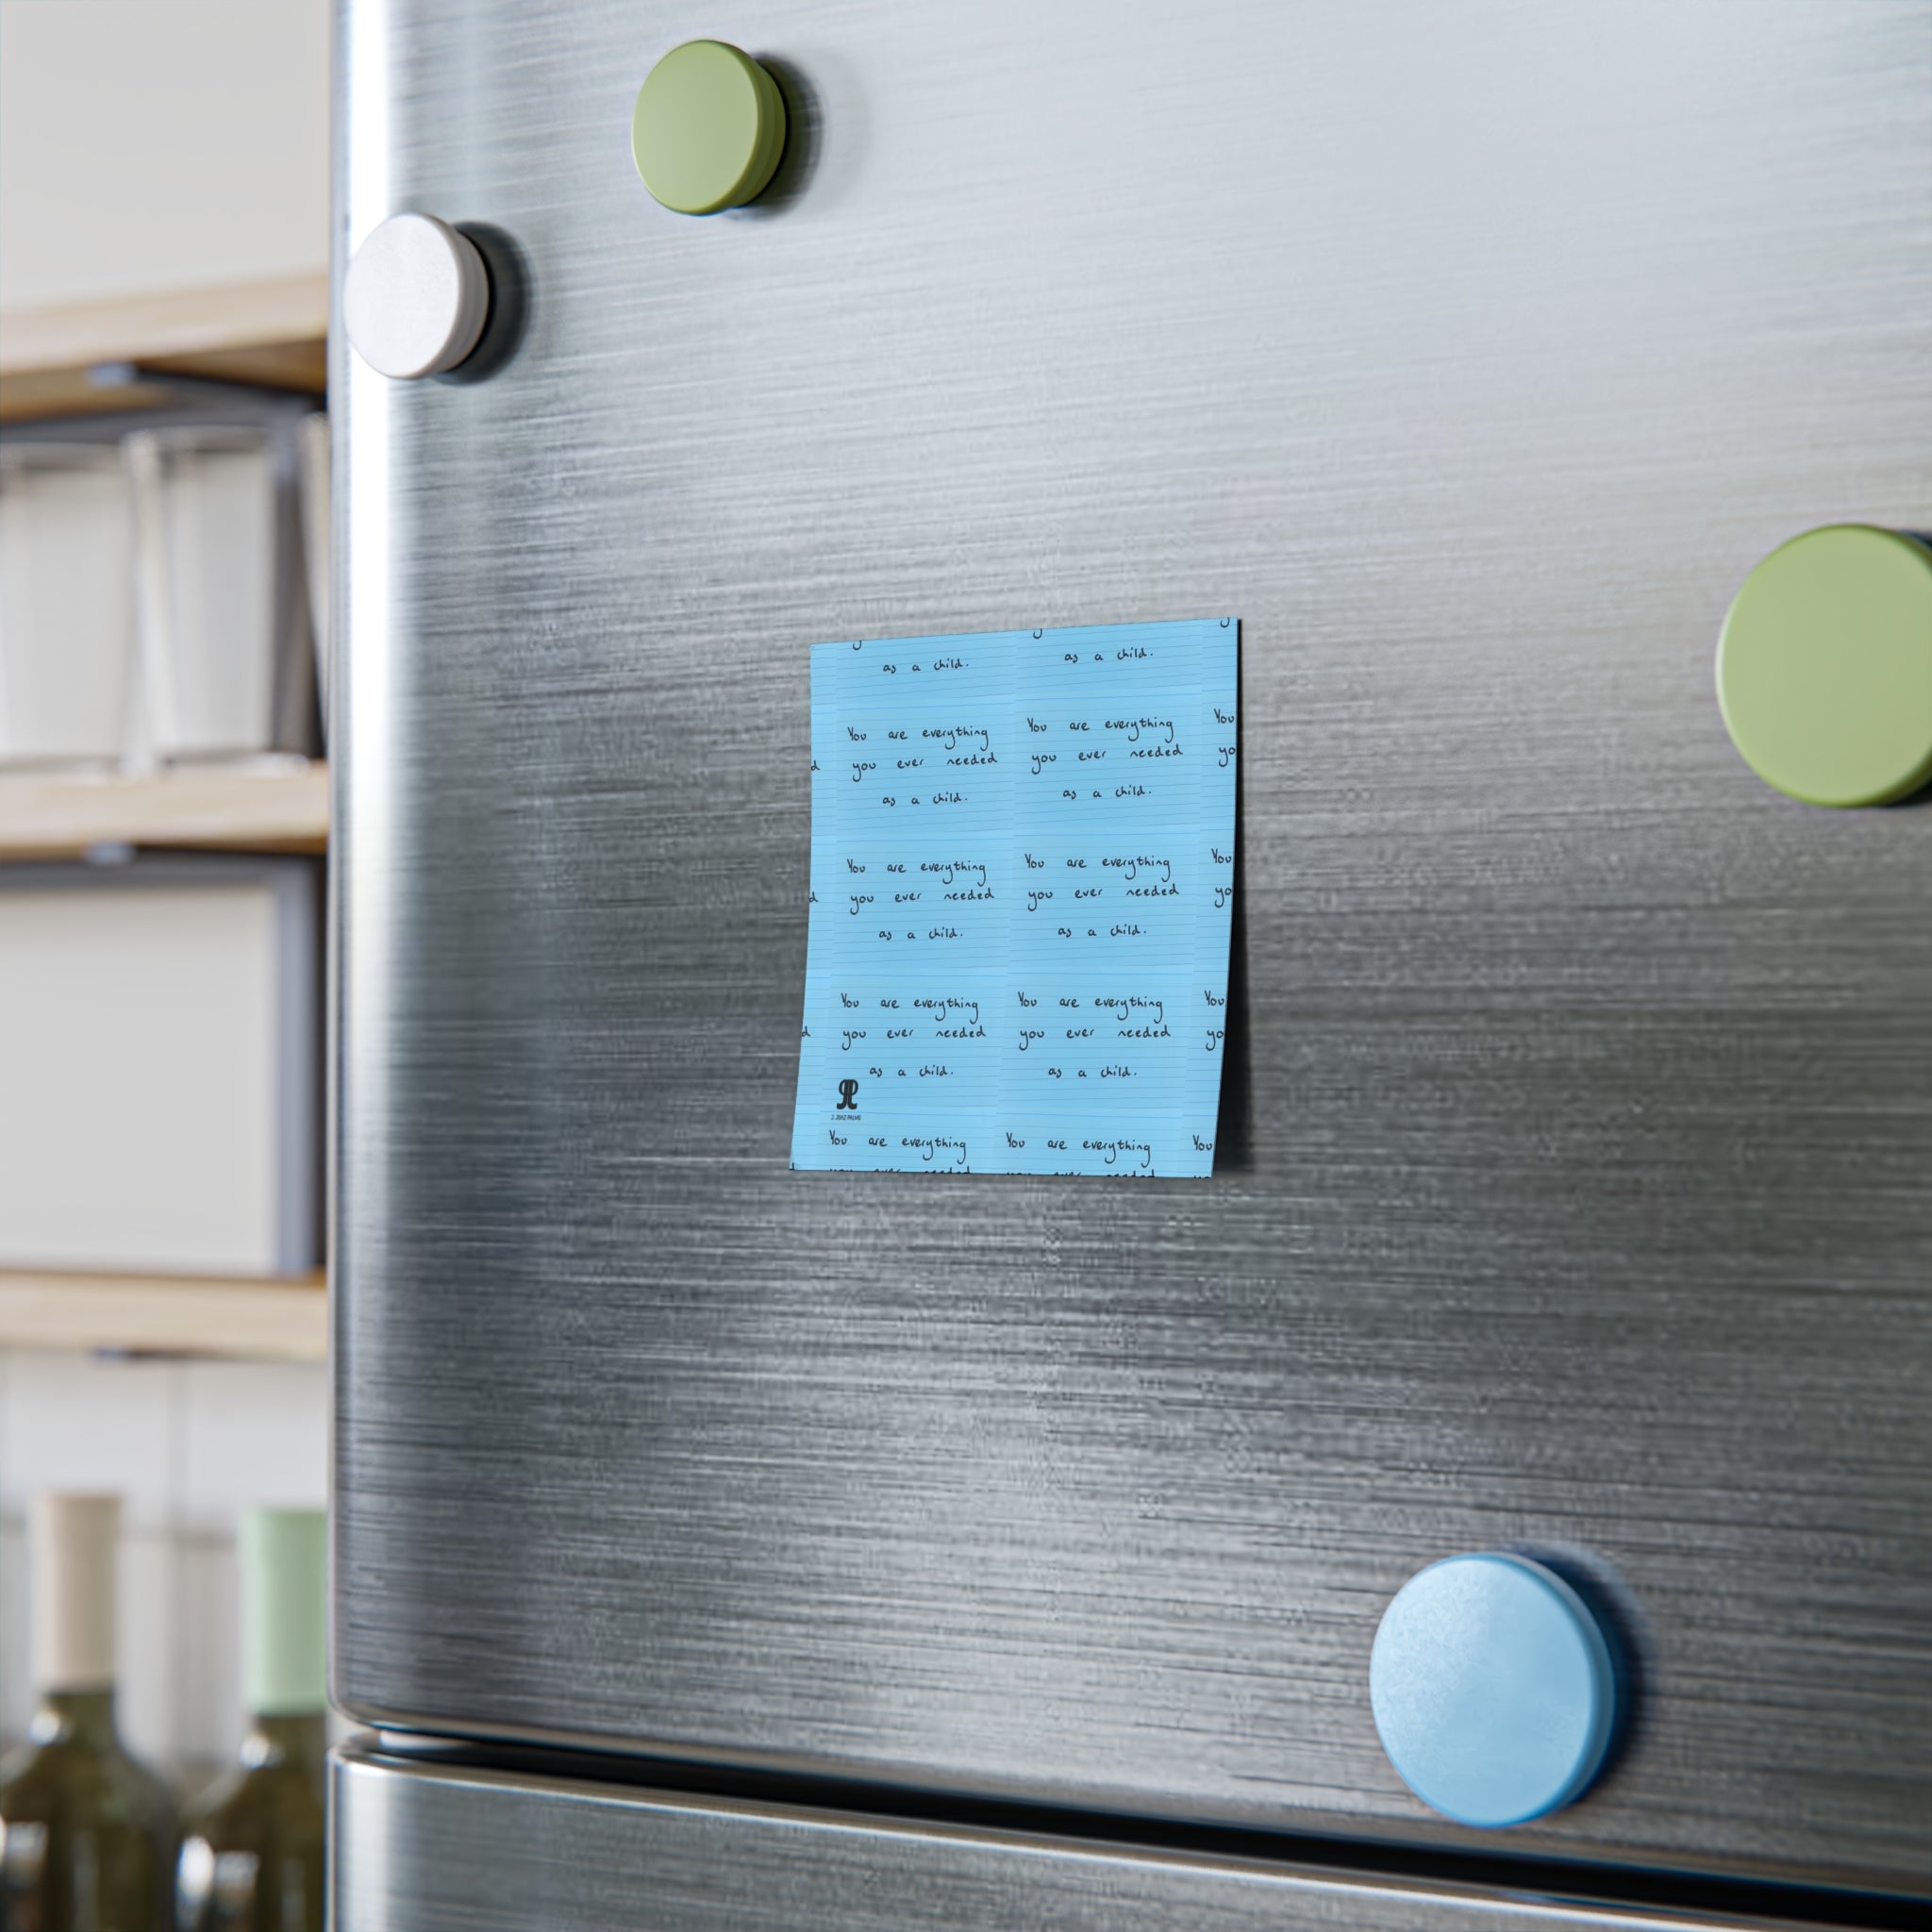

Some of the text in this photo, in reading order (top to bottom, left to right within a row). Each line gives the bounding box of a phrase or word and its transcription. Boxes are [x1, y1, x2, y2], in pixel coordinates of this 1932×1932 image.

[883, 665, 896, 674] as
[934, 658, 968, 671] child.
[1065, 654, 1078, 663] as
[1117, 647, 1153, 659] child.
[1214, 708, 1234, 724] You
[848, 726, 989, 751] You are everything
[1027, 717, 1174, 743] You are everything
[853, 752, 997, 782] you ever needed
[1032, 744, 1183, 774] you ever needed
[883, 797, 895, 807] as
[933, 792, 967, 804] child.
[1063, 791, 1076, 800] as
[1116, 785, 1151, 797] child.
[1025, 854, 1171, 882] You are everything
[1211, 849, 1231, 863] You
[847, 858, 986, 887] You are everything
[850, 888, 994, 915] you ever needed
[1028, 883, 1179, 911] you ever needed
[879, 931, 891, 941] as
[929, 927, 962, 939] child.
[1058, 928, 1072, 938] as
[1110, 924, 1146, 936] child.
[841, 993, 978, 1024] You are everything
[1018, 991, 1162, 1024] You are everything
[1205, 991, 1224, 1006] You
[842, 1025, 986, 1050] you ever needed
[1019, 1025, 1171, 1051] you ever needed
[870, 1068, 882, 1077] as
[920, 1065, 953, 1076] child.
[1048, 1068, 1061, 1078] as
[1101, 1065, 1136, 1077] child.
[829, 1130, 966, 1164] You are everything
[1007, 1132, 1150, 1168] You are everything
[1192, 1135, 1212, 1151] You
